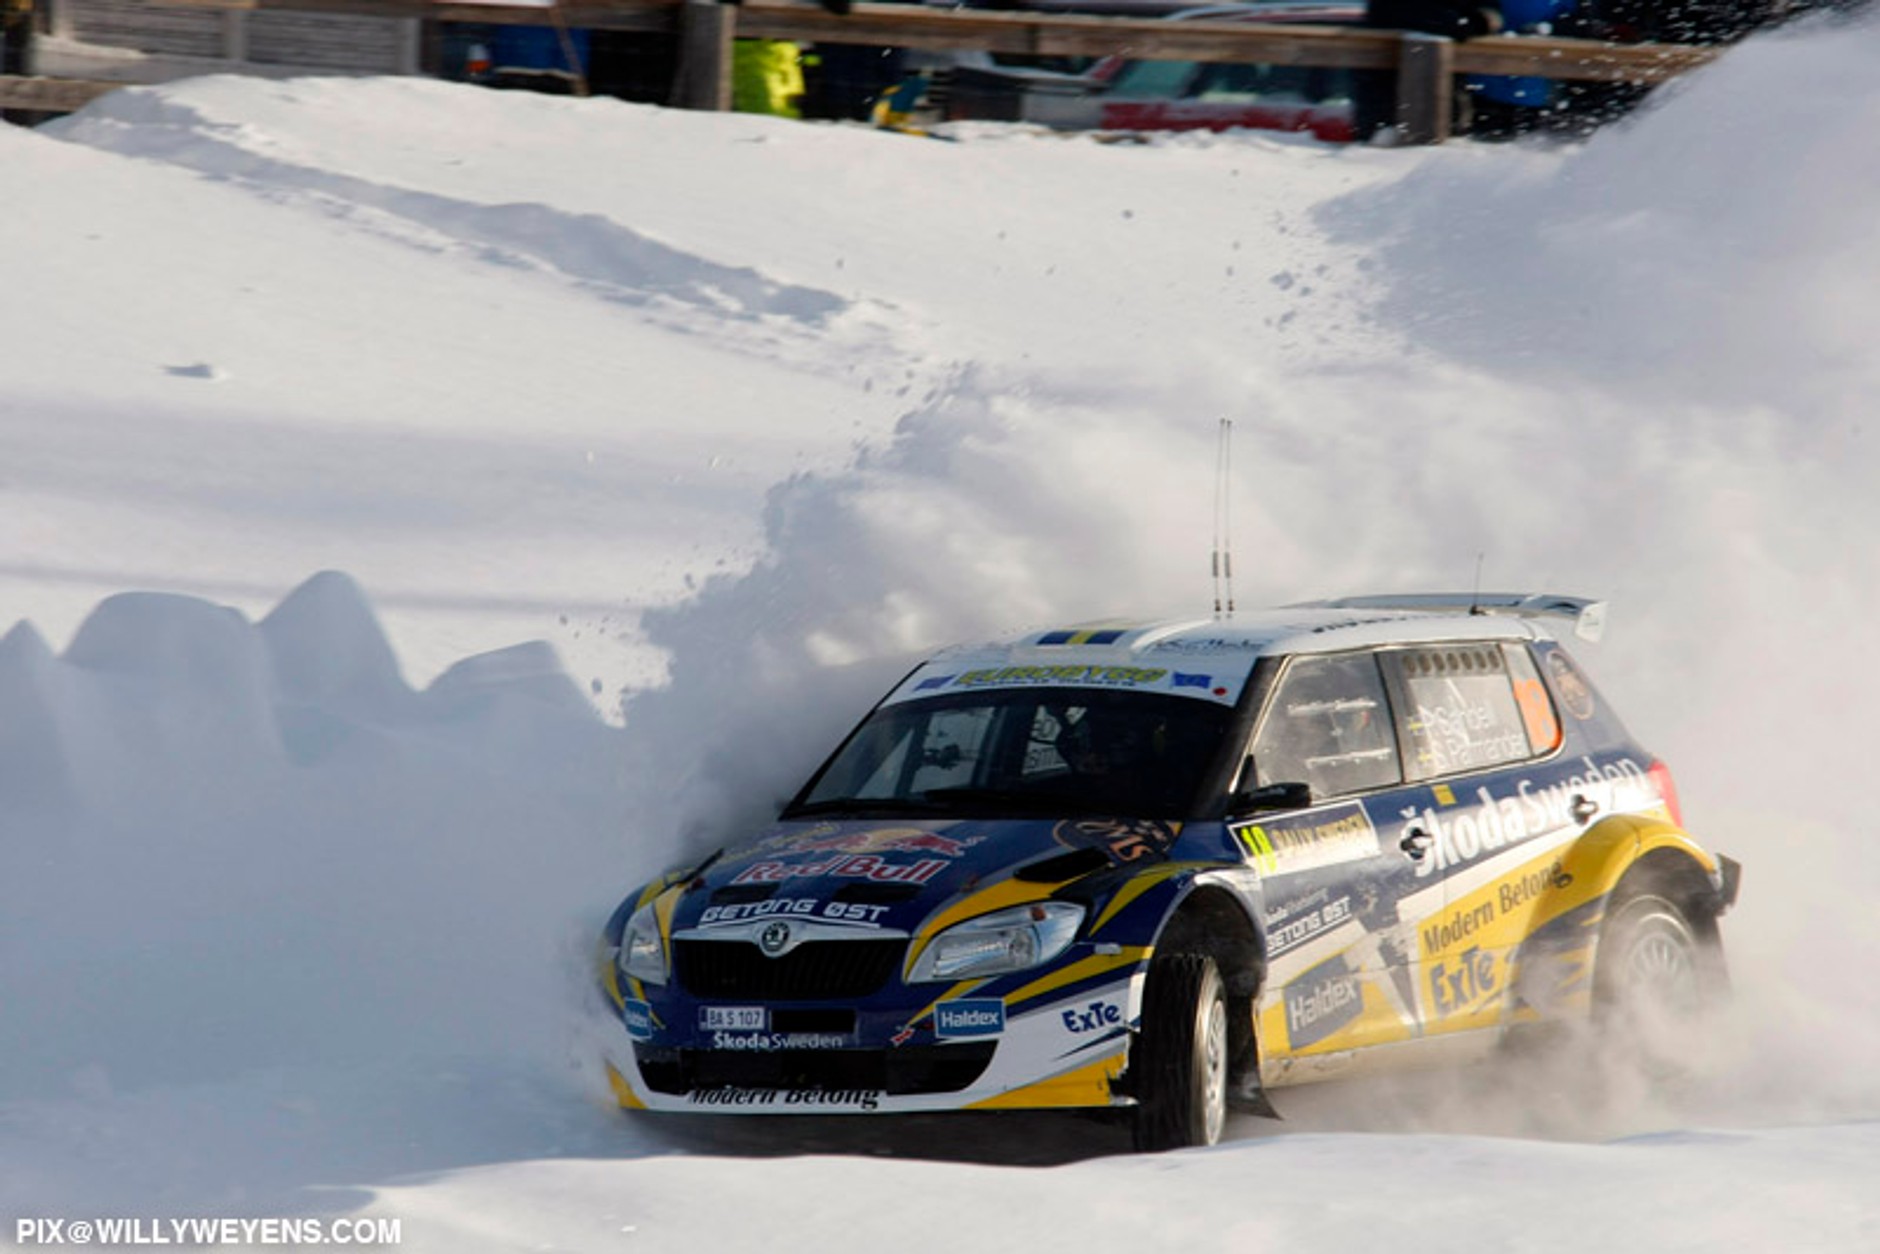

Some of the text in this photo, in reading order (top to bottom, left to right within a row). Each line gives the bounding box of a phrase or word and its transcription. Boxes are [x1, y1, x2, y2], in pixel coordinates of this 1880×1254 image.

[735, 855, 950, 885] Red Bull
[700, 900, 817, 922] BETONG
[1424, 858, 1573, 954] Modern Betong
[1429, 946, 1497, 1019] ExTe
[738, 1009, 762, 1027] 107
[940, 1008, 999, 1028] Haldex
[1061, 1002, 1121, 1035] ExTe
[1289, 976, 1357, 1032] Haldex
